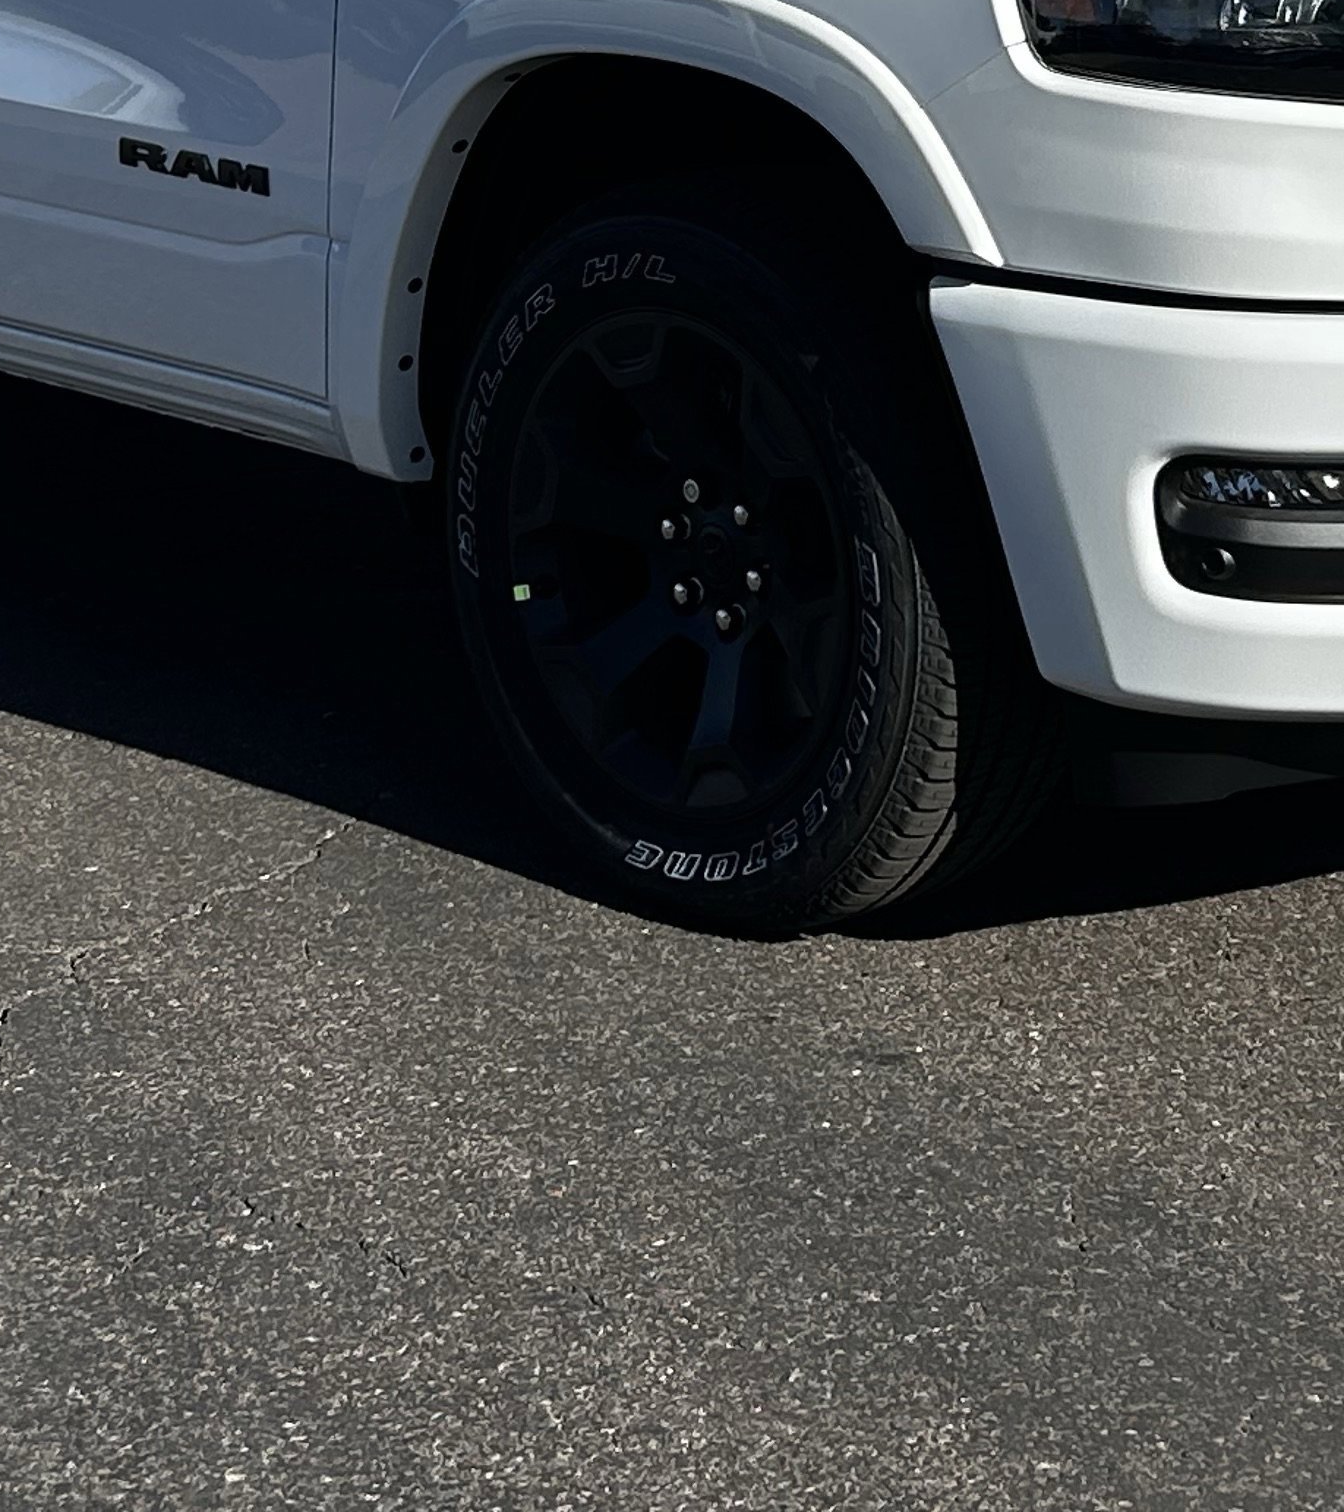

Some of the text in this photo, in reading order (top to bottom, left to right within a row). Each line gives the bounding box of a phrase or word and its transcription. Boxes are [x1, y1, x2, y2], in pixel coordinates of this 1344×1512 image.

[119, 137, 270, 197] RAM
[582, 252, 677, 288] H/L
[624, 534, 881, 883] BRIDGESTONE
